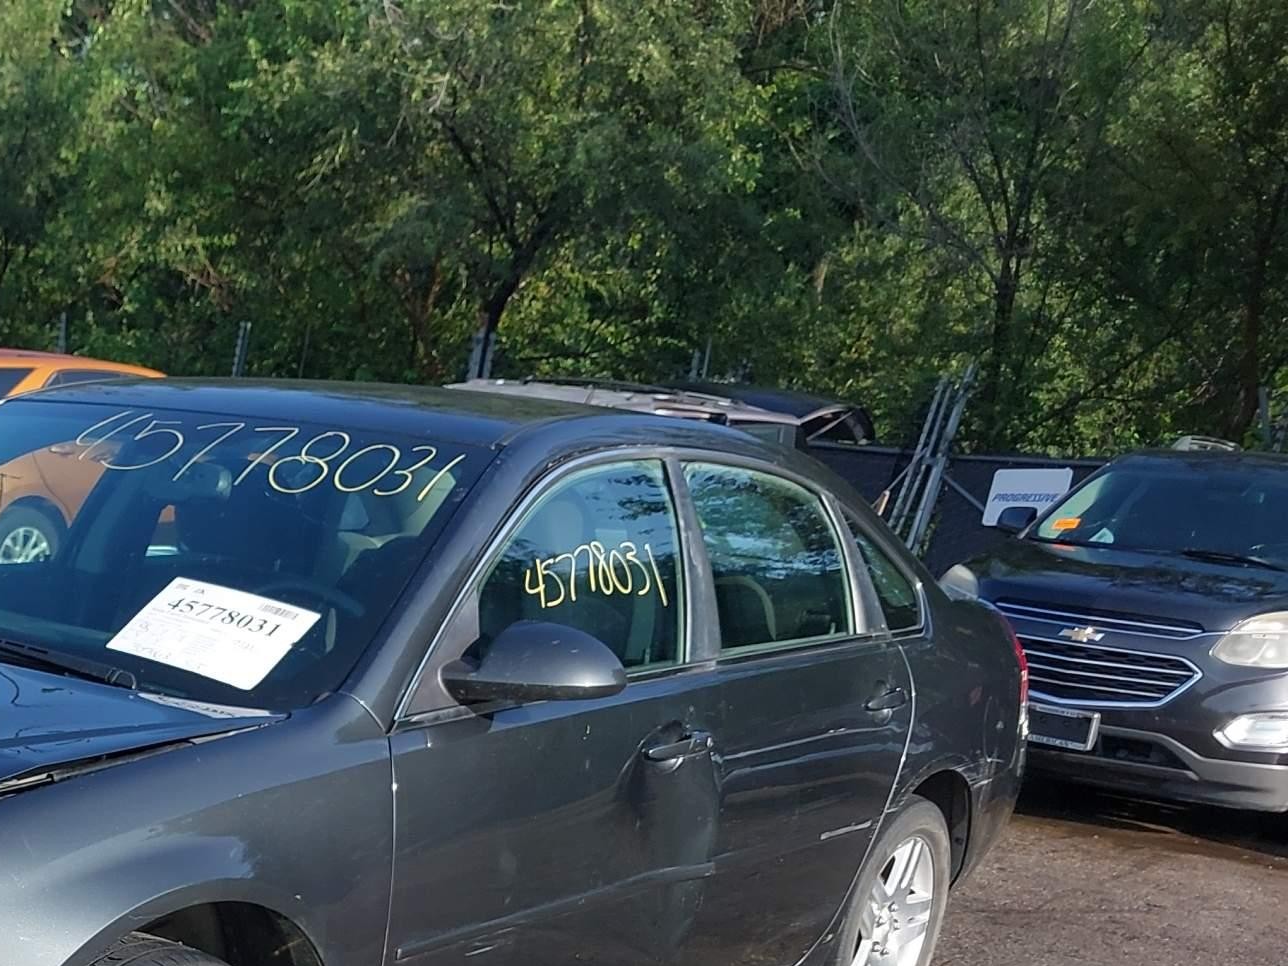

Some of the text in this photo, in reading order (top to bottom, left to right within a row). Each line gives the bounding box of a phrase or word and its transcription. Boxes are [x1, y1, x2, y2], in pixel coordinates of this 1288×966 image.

[76, 410, 467, 502] 45778031
[525, 541, 668, 608] 45778031
[167, 597, 281, 637] 45778031
